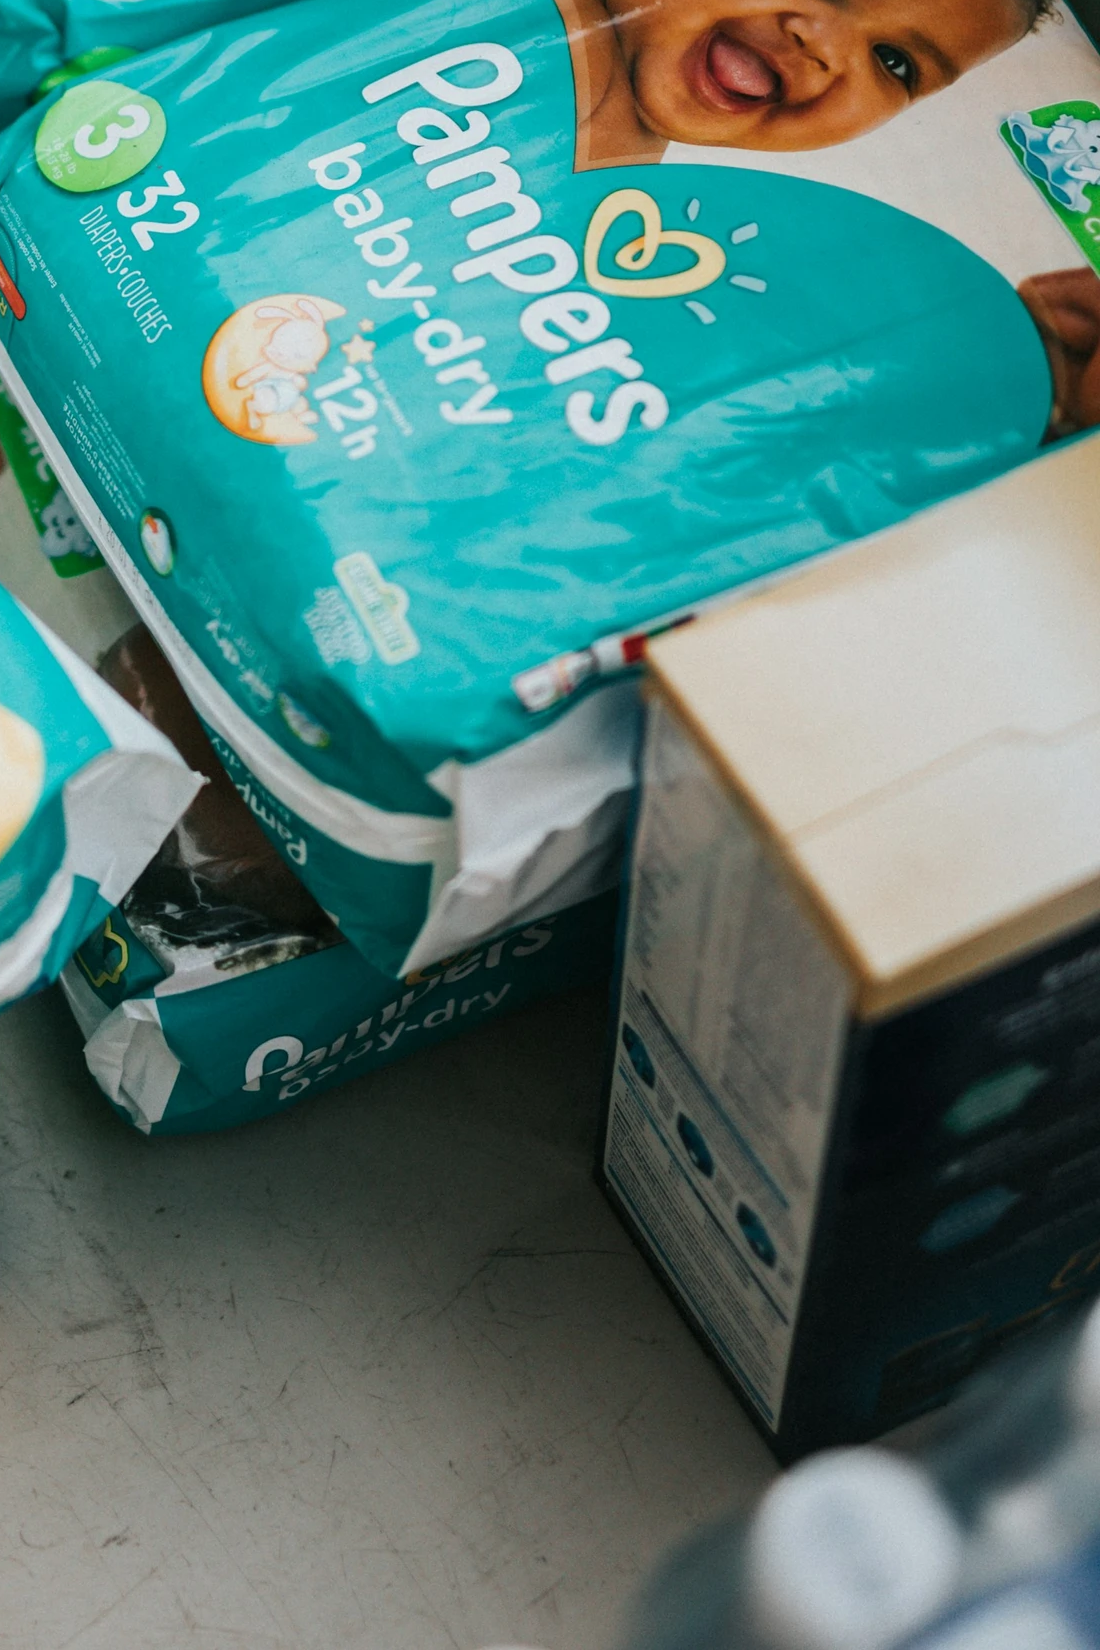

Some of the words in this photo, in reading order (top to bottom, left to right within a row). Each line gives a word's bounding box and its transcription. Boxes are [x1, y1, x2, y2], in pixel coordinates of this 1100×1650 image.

[73, 104, 151, 159] 3
[116, 169, 199, 251] 32
[362, 42, 669, 446] Pampers
[308, 141, 512, 426] baby-dry
[312, 366, 378, 460] 12h
